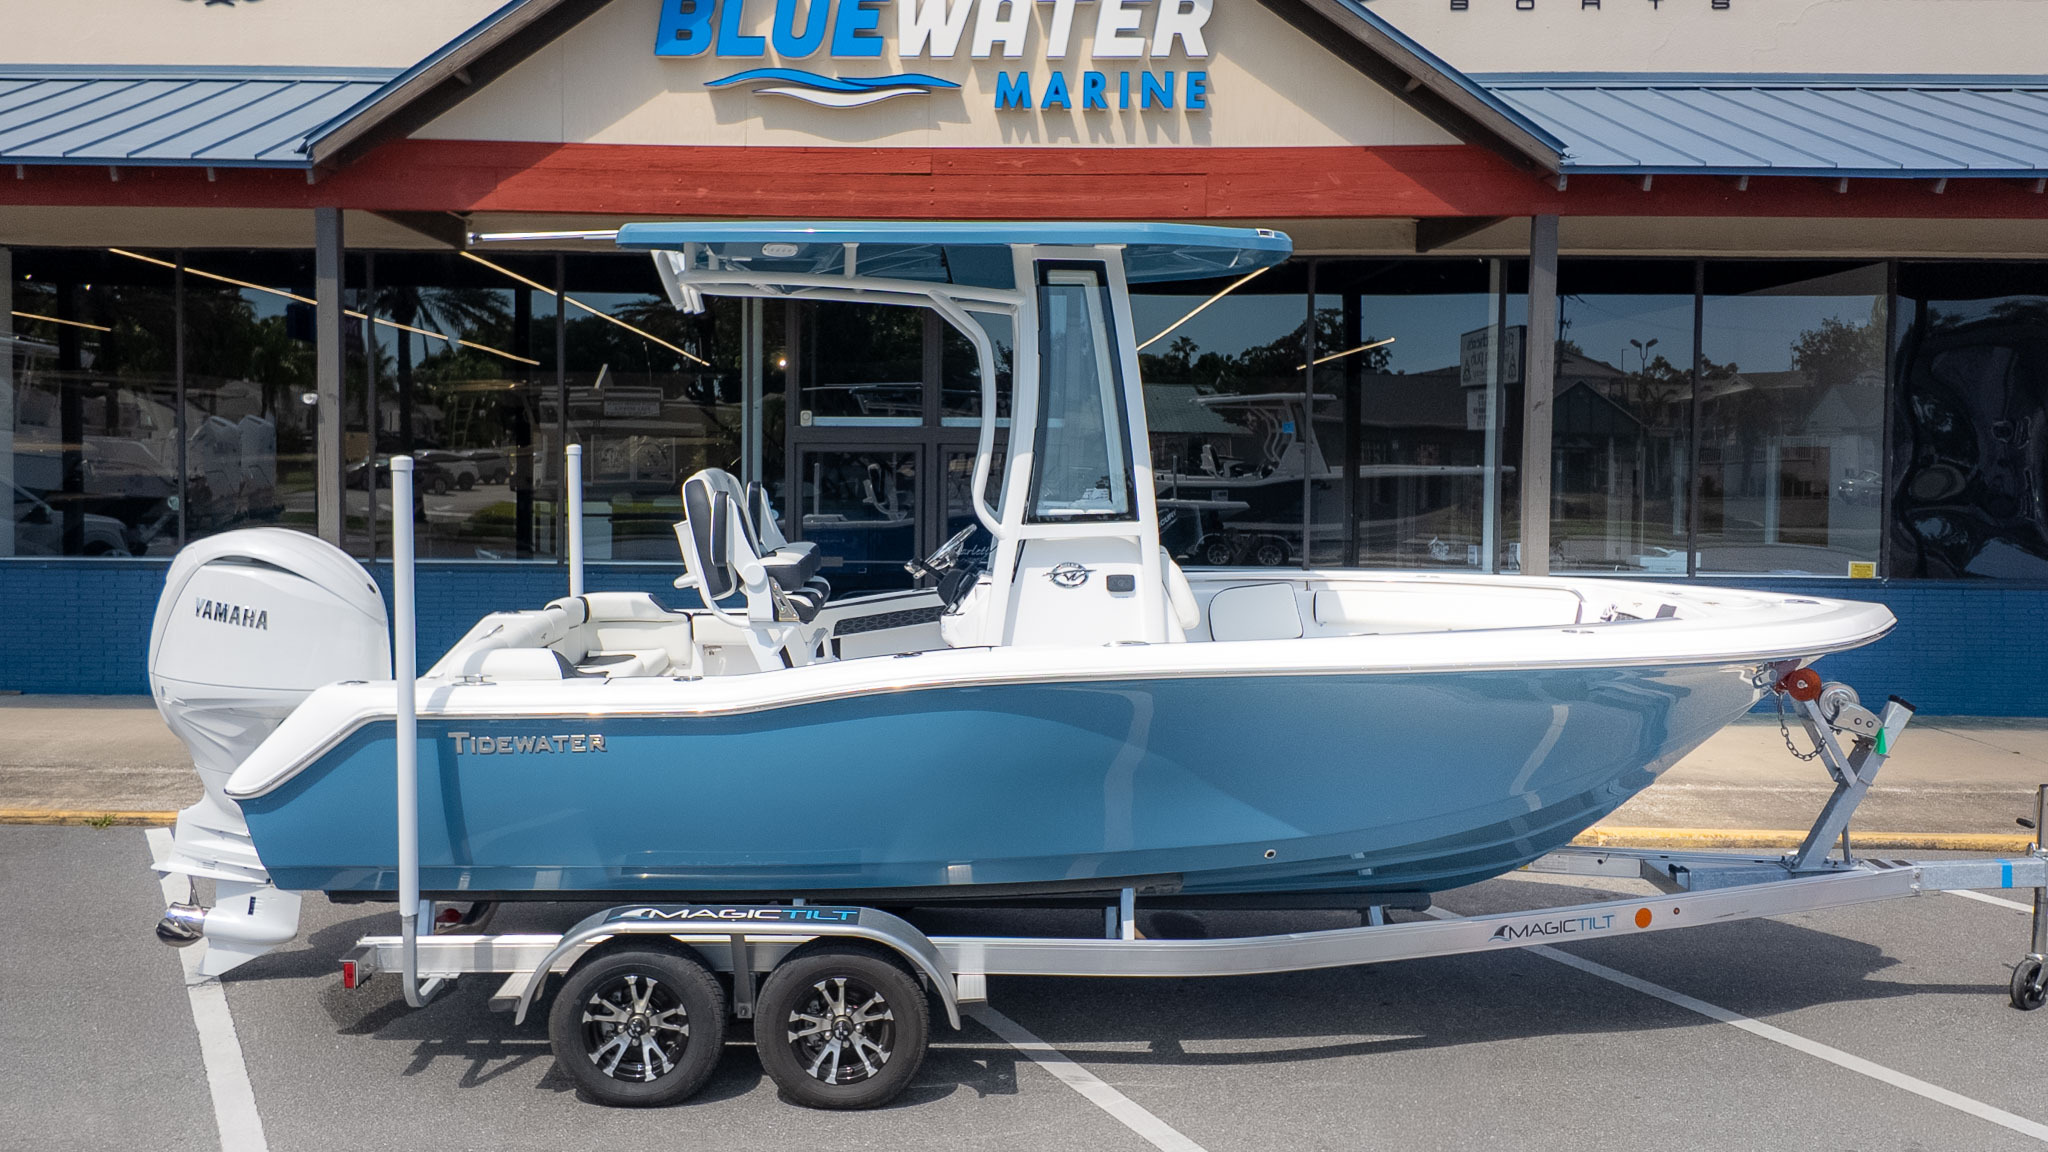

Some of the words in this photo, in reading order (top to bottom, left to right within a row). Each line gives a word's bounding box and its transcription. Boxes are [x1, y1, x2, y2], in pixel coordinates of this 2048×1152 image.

[995, 71, 1206, 109] MARINE
[196, 597, 268, 630] YAMAHA
[649, 908, 858, 921] MAGICTILT
[1508, 914, 1615, 939] MAGICTILT
